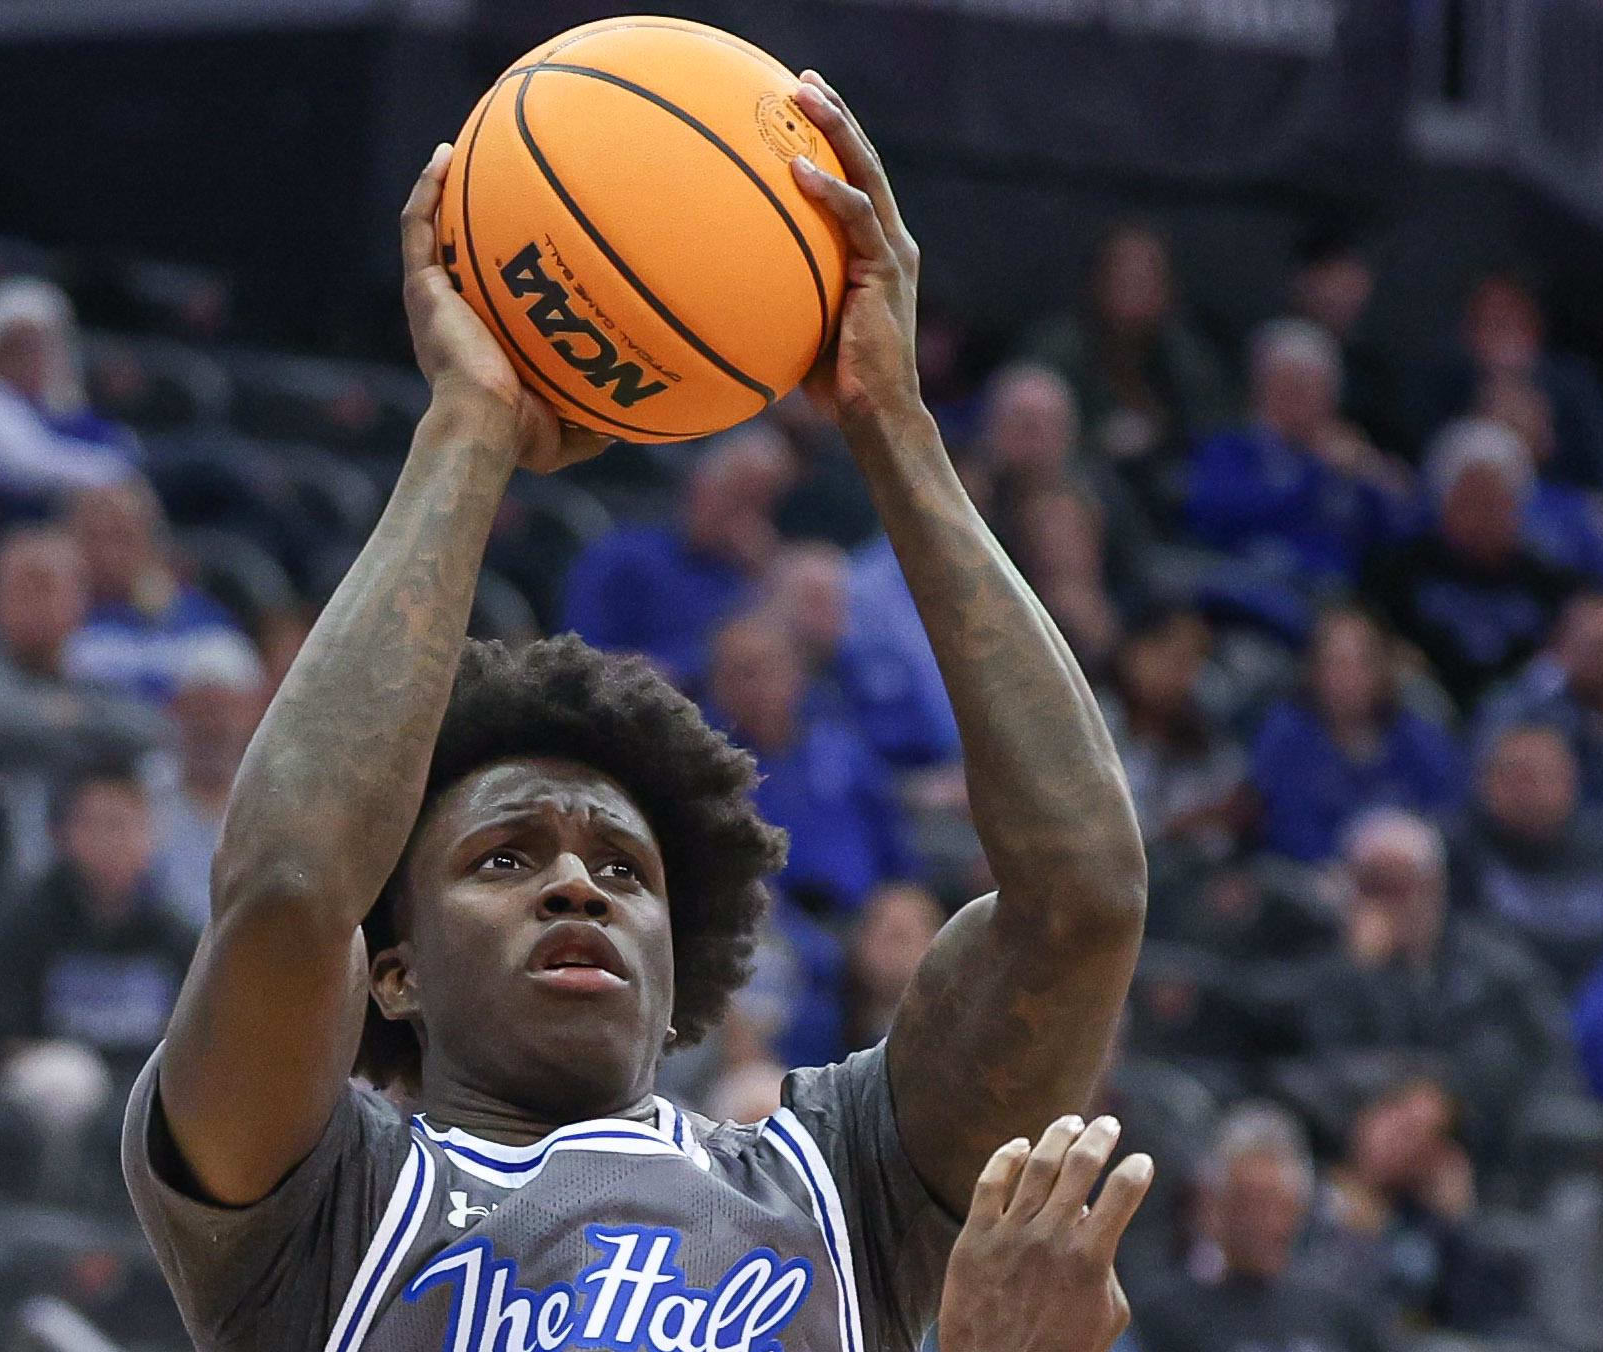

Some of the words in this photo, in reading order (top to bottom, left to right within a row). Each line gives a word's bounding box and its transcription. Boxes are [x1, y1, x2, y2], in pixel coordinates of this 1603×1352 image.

[544, 232, 575, 282] BALL
[500, 241, 669, 409] NCAA
[572, 282, 616, 330] GAME
